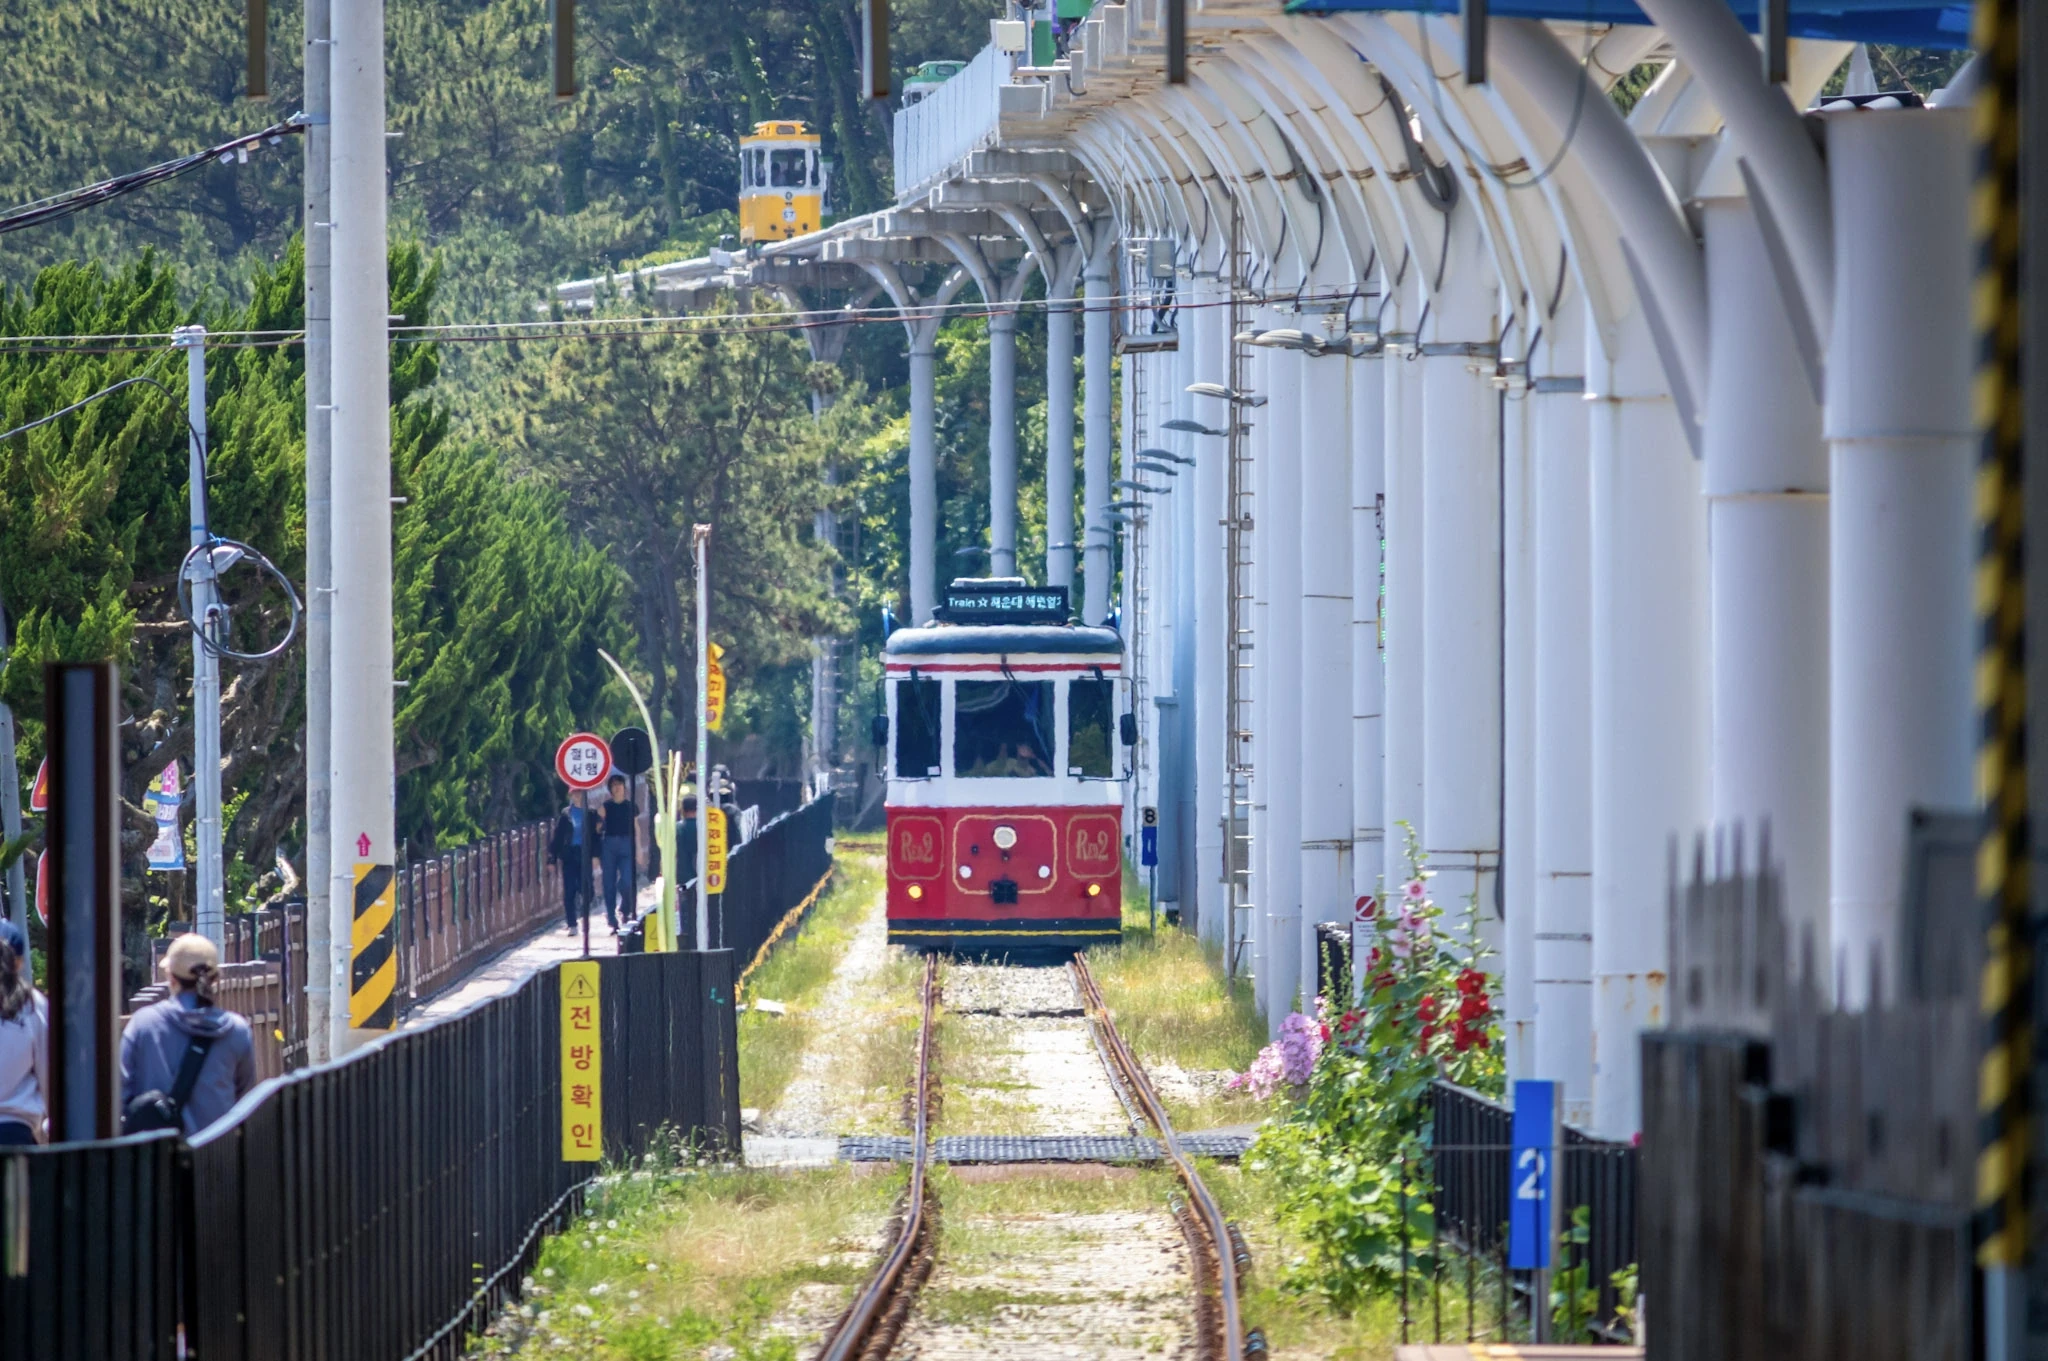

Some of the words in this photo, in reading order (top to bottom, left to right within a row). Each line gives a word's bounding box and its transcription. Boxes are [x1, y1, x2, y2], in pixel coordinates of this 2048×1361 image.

[948, 597, 976, 608] Train
[571, 747, 598, 761] 절대
[570, 762, 598, 777] 서행
[1144, 808, 1156, 824] 8
[570, 1005, 594, 1149] 전방확인
[1517, 1147, 1547, 1200] 2
